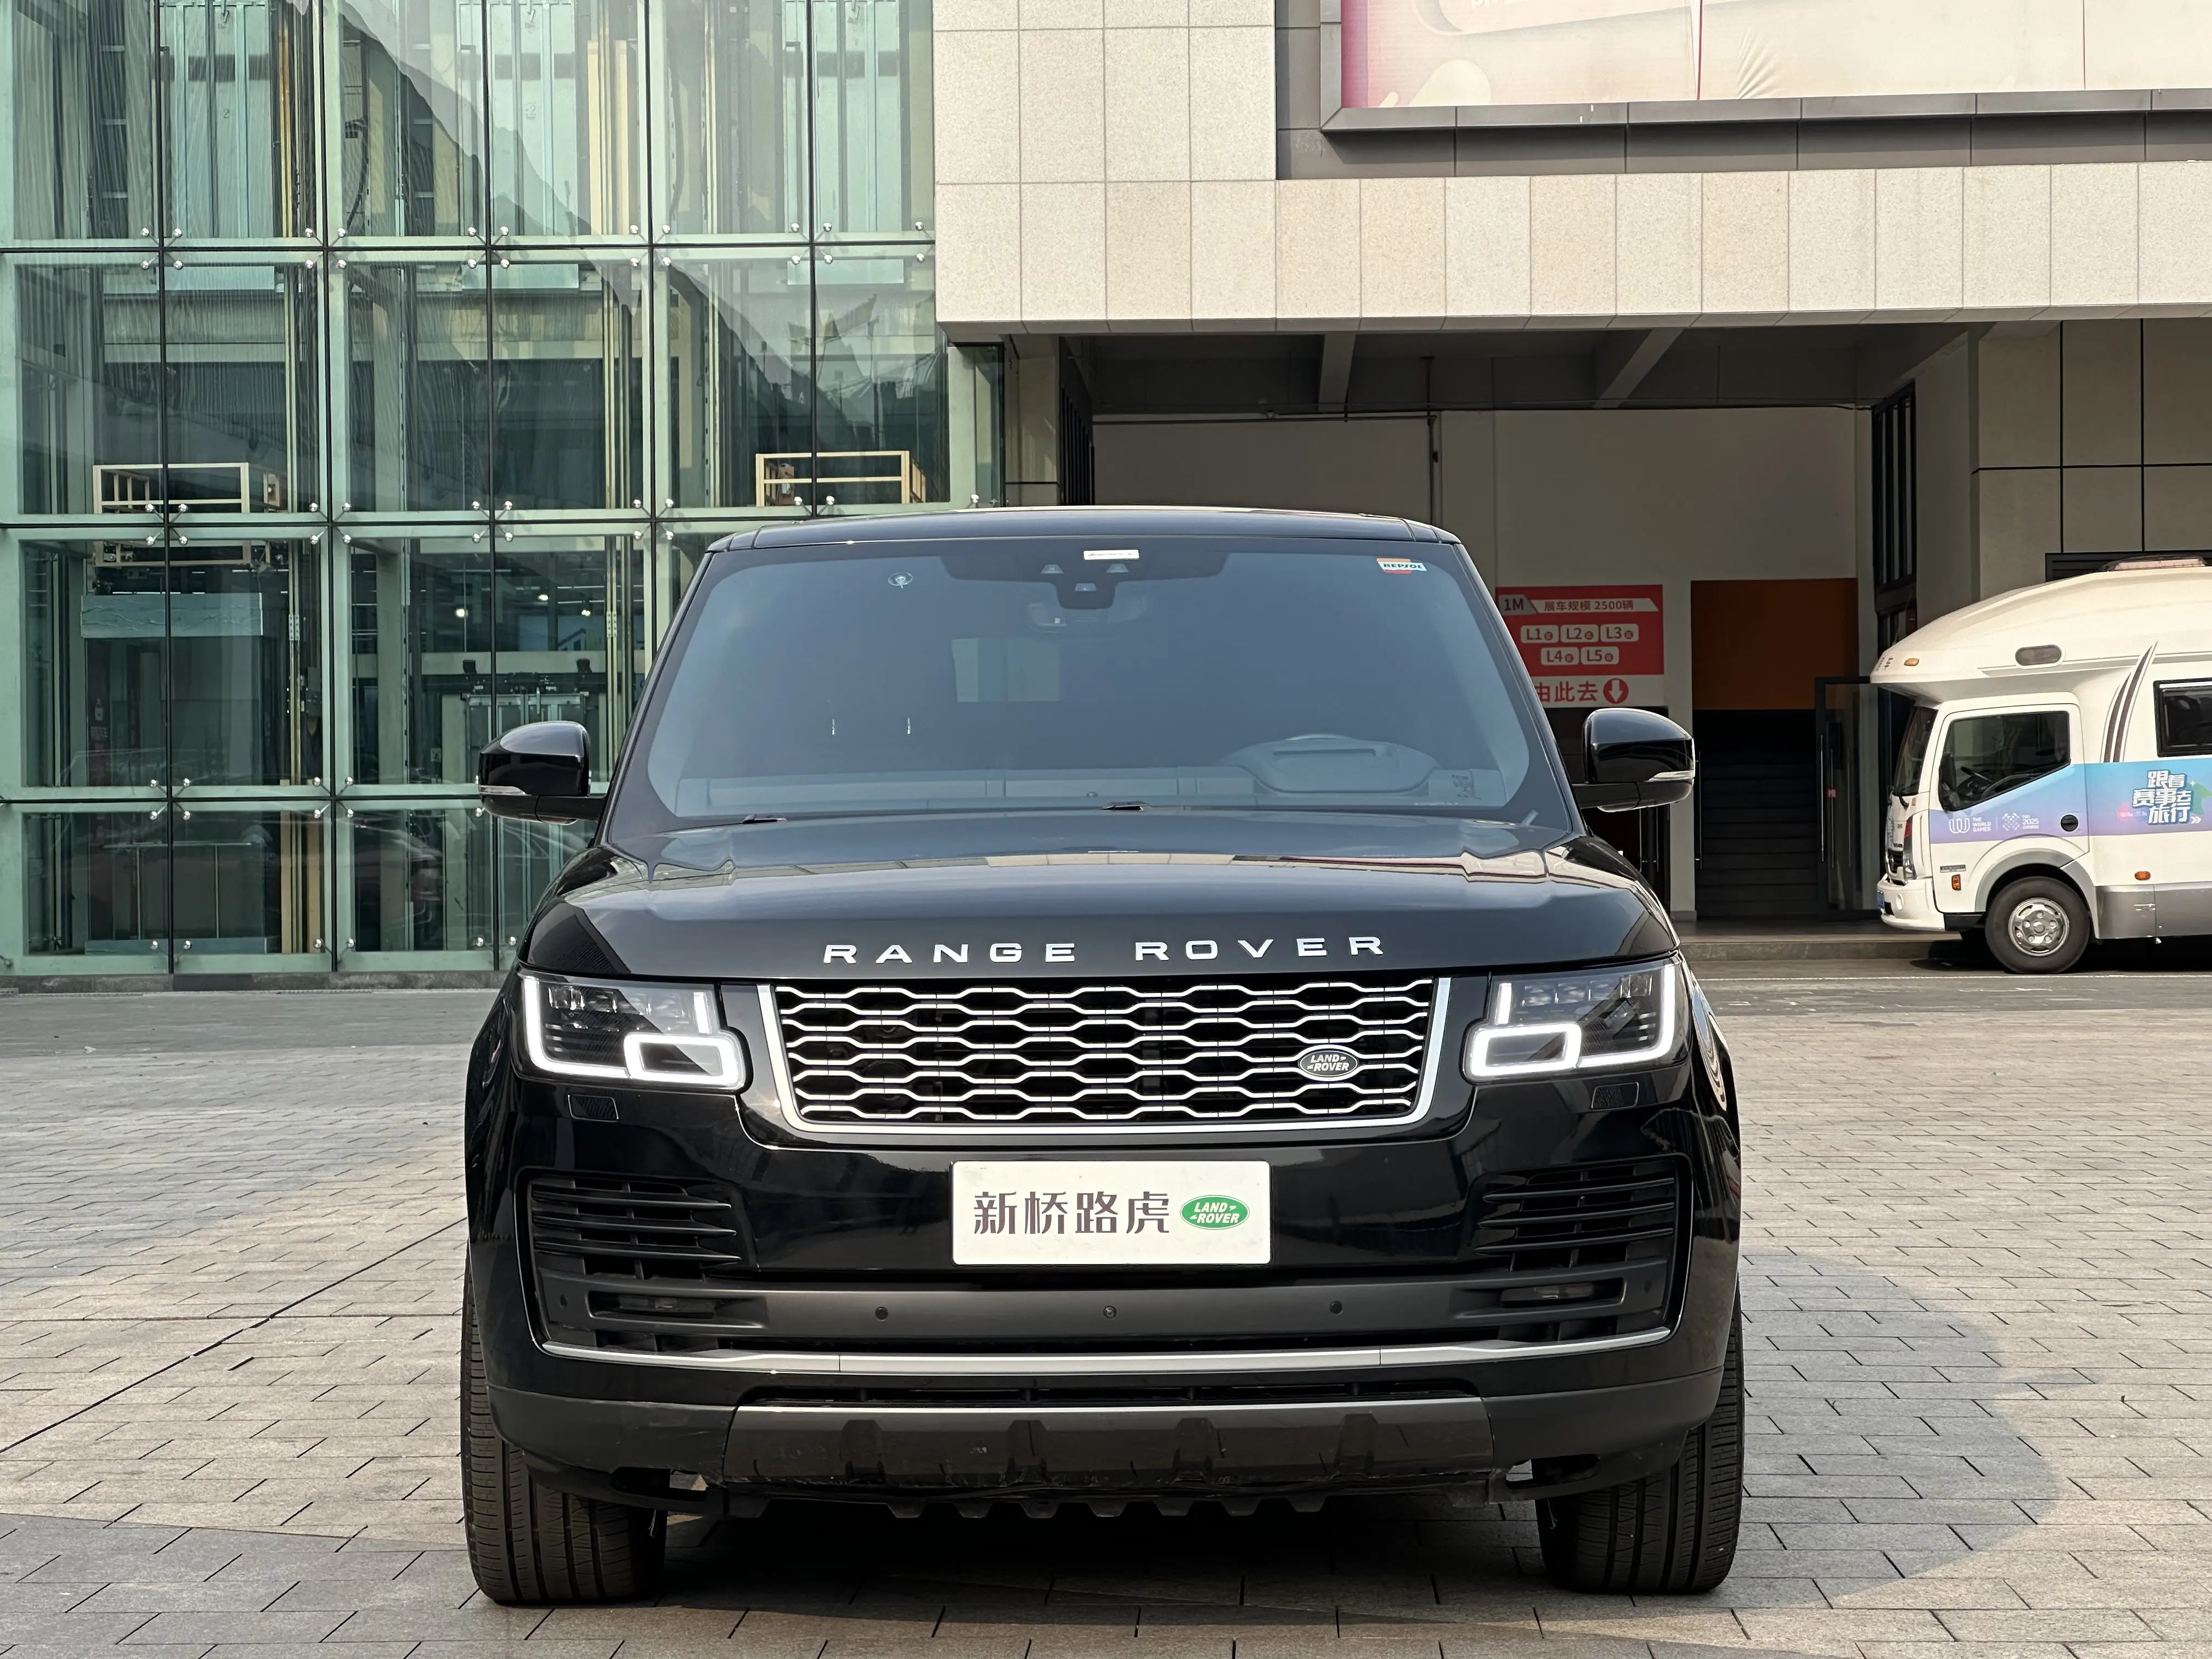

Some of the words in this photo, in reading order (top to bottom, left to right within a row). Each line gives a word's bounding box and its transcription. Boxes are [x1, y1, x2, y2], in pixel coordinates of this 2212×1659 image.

[1504, 599, 1524, 611] 1M
[1544, 601, 1591, 611] 展车规模
[1594, 600, 1634, 611] 2500辆
[1535, 681, 1598, 703] 由此去
[2132, 788, 2192, 807] 赛事去
[2148, 803, 2191, 823] 旅行
[822, 942, 1076, 965] RANGE
[1134, 936, 1385, 962] ROVER
[1310, 1054, 1340, 1063] LAND
[1313, 1062, 1350, 1071] ROVER
[974, 1191, 1170, 1234] 新桥路虎
[1194, 1201, 1228, 1212] LAND
[1197, 1213, 1240, 1223] ROVER
